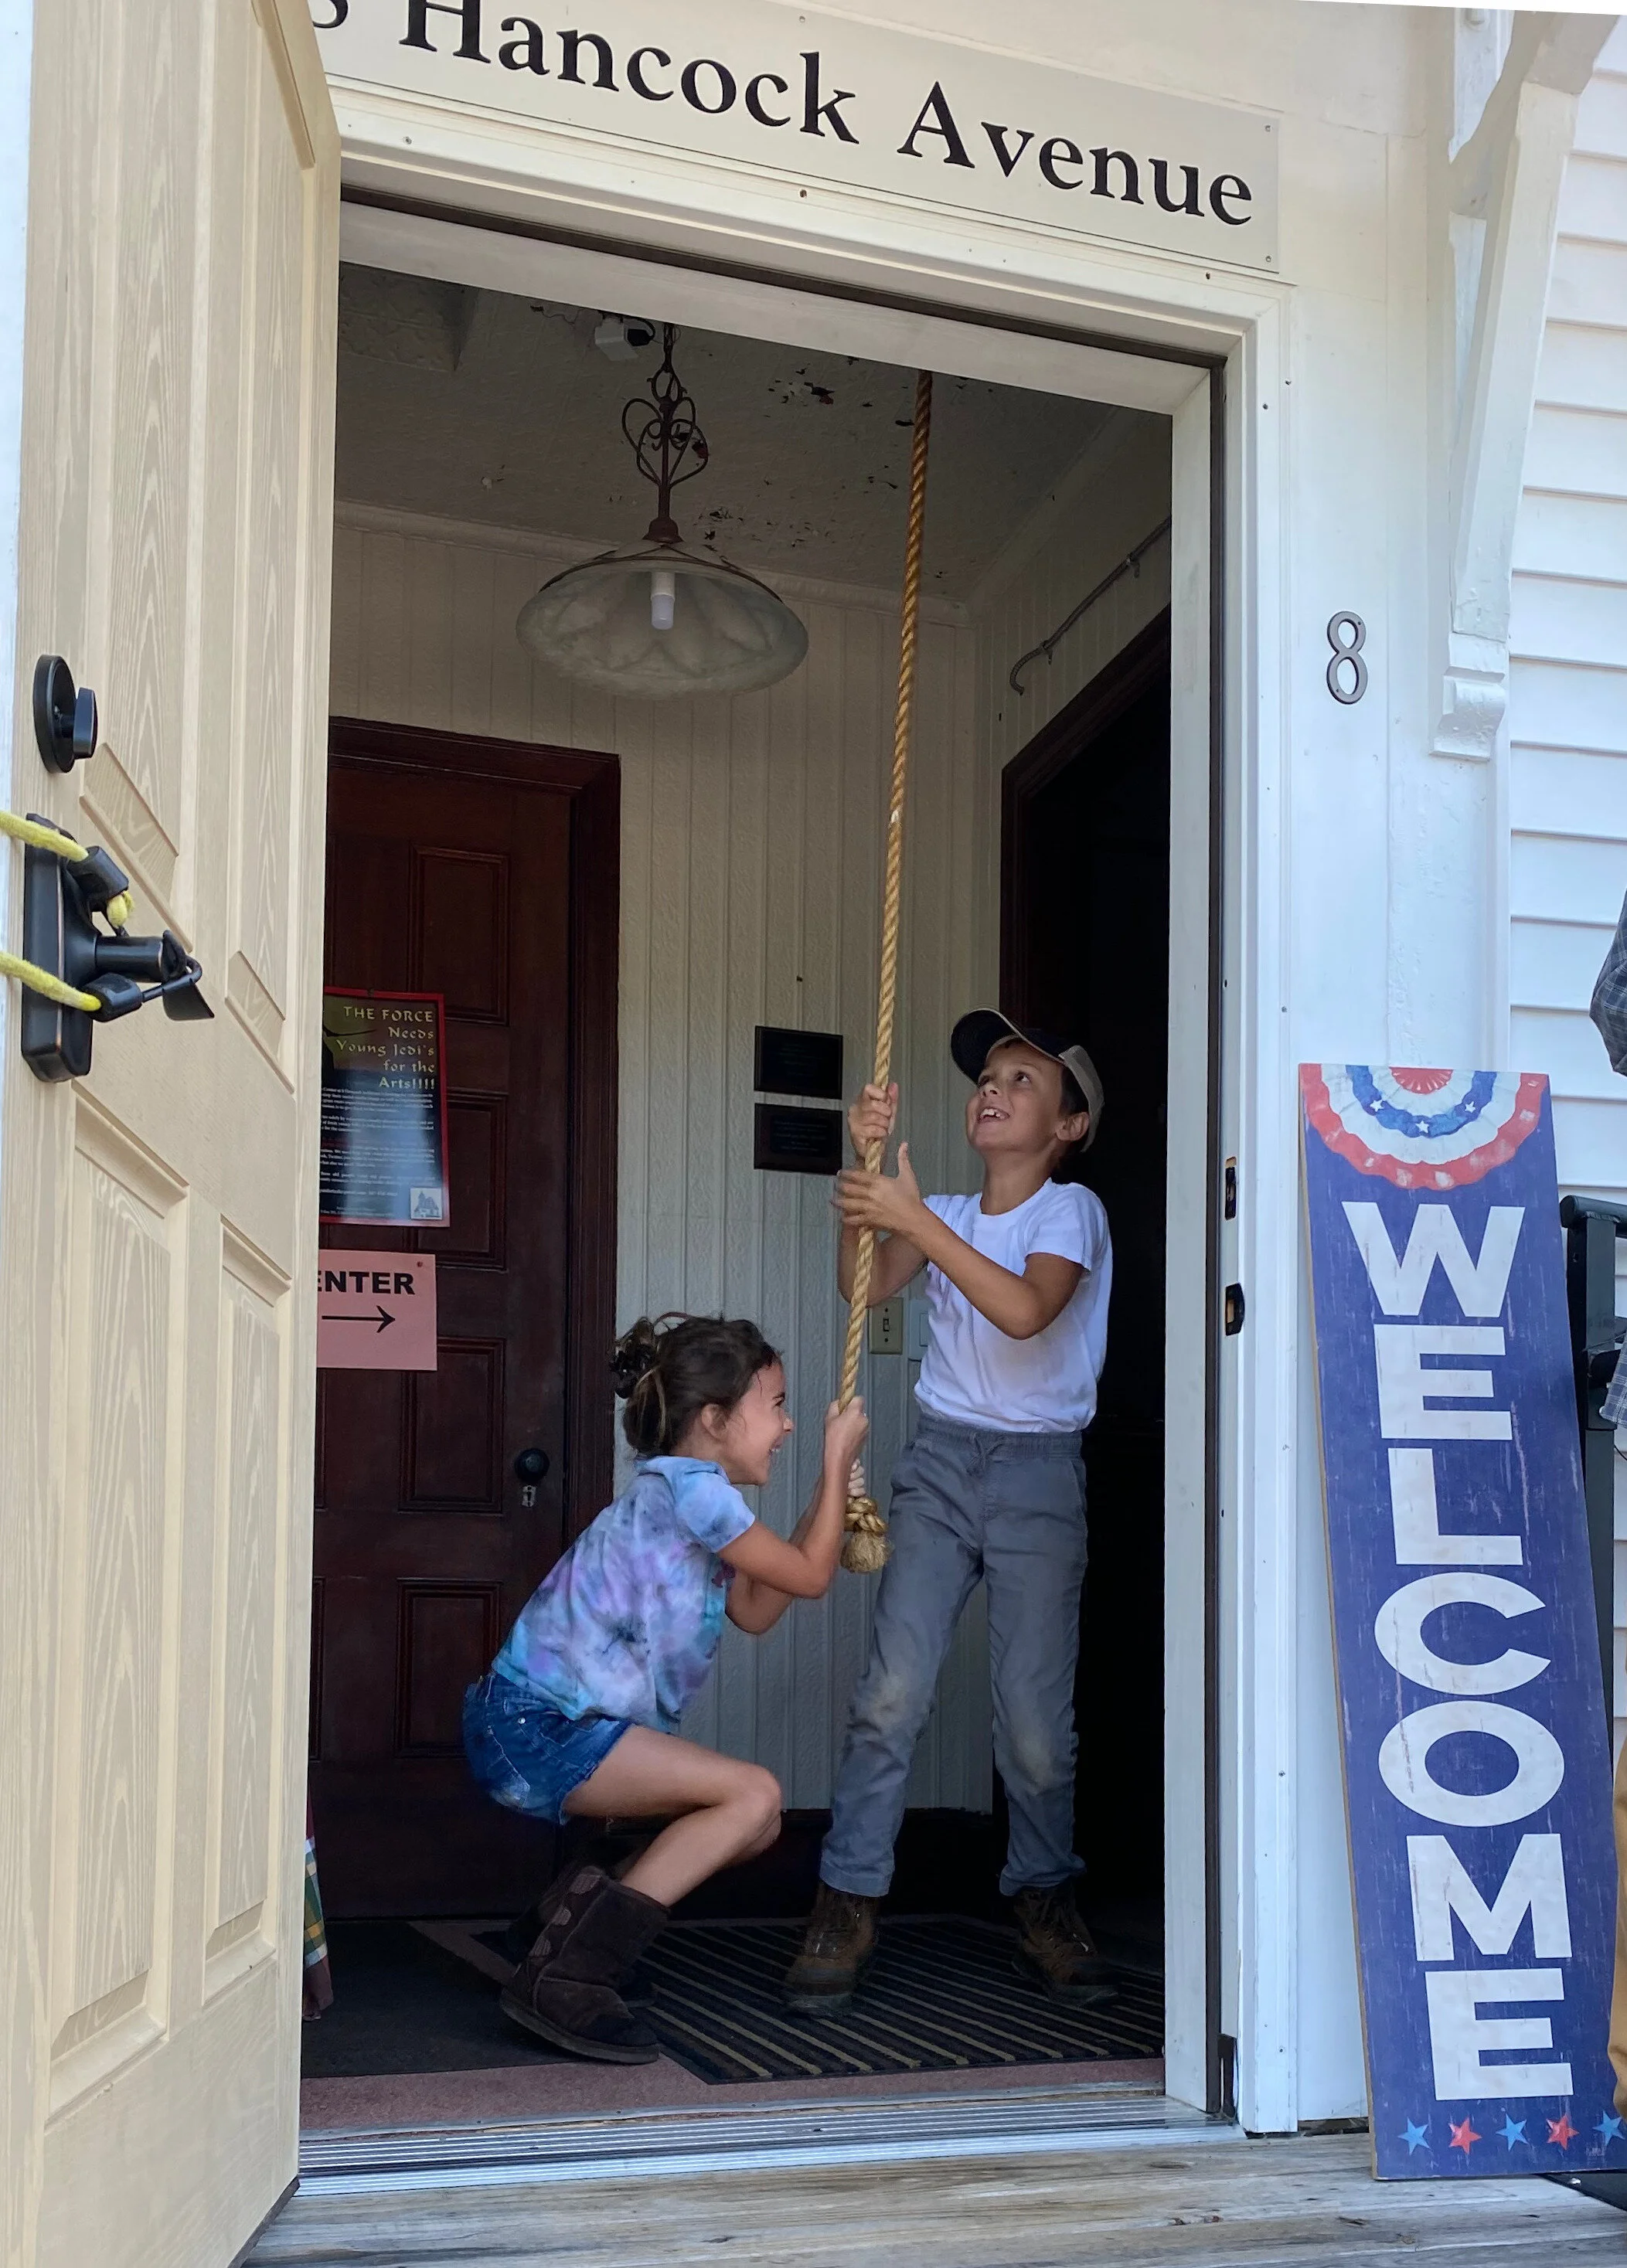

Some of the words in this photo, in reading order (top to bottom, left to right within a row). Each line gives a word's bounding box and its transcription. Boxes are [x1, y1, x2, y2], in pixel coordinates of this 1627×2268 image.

[399, 0, 859, 145] Hancock
[897, 80, 1252, 226] Avenue
[1326, 610, 1368, 705] 8
[343, 1006, 375, 1020] THE
[382, 1009, 434, 1022] FORCE
[388, 1026, 434, 1039] Needs
[336, 1039, 386, 1057] Young
[393, 1043, 434, 1056] Jedi's
[383, 1059, 406, 1072] for
[412, 1060, 435, 1073] the
[379, 1076, 435, 1090] Arts!!!!
[318, 1270, 415, 1295] NTER
[1341, 1201, 1574, 2101] WELCOME
